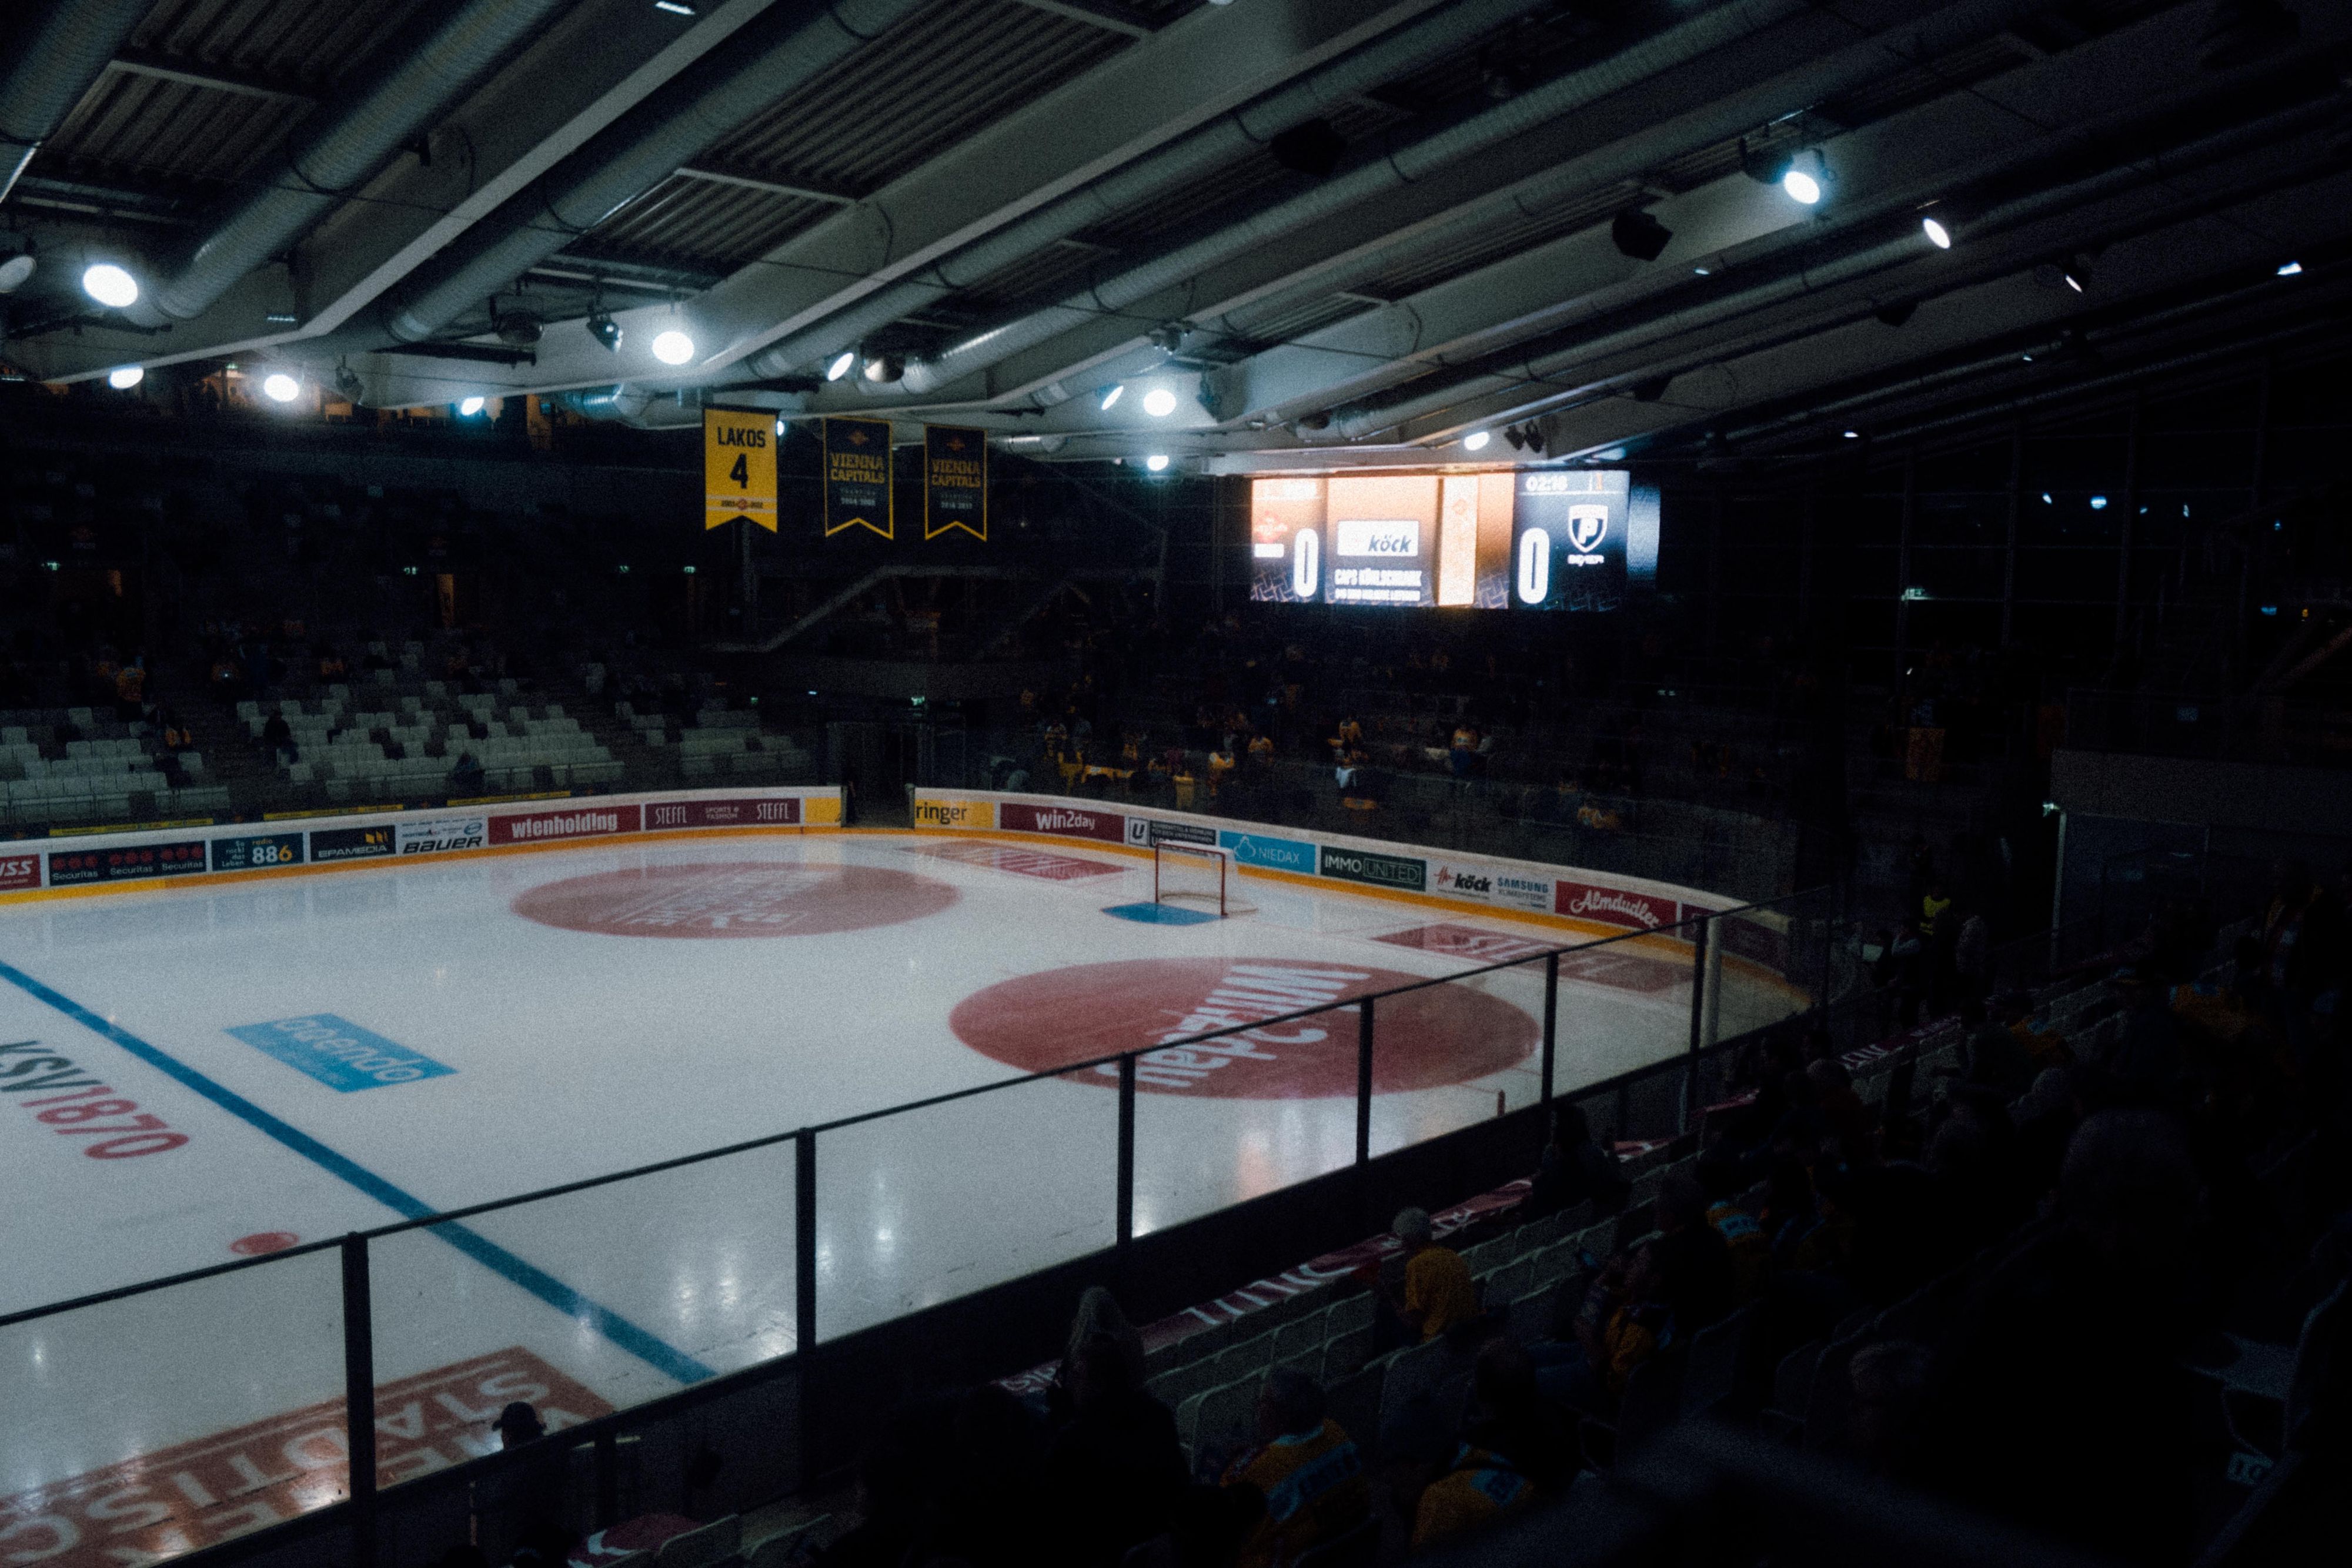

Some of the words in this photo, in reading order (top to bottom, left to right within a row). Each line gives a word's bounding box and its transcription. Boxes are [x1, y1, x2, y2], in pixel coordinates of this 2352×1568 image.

[717, 427, 766, 448] LAKOS
[730, 453, 749, 489] 4
[830, 452, 886, 472] VIENNA
[830, 469, 886, 484] CAPITALS
[931, 473, 981, 489] CAPITALS
[1368, 534, 1412, 553] köck
[1294, 528, 1319, 597] 0
[1518, 527, 1551, 604] 0
[654, 805, 687, 825] STEFFL
[756, 802, 790, 820] STEFFL
[318, 844, 387, 858] EPAMEDIA
[403, 836, 483, 854] BAUER
[1258, 845, 1300, 864] NIEDAX
[252, 845, 293, 865] 886
[52, 870, 99, 881] Securitas
[110, 864, 154, 875] Securitas
[162, 861, 204, 871] Securitas
[1324, 854, 1362, 873] IMMO
[1365, 861, 1418, 882] UNITED
[1454, 873, 1492, 892] köck
[1497, 877, 1549, 894] SAMSUNG
[1570, 889, 1659, 929] Almdudler
